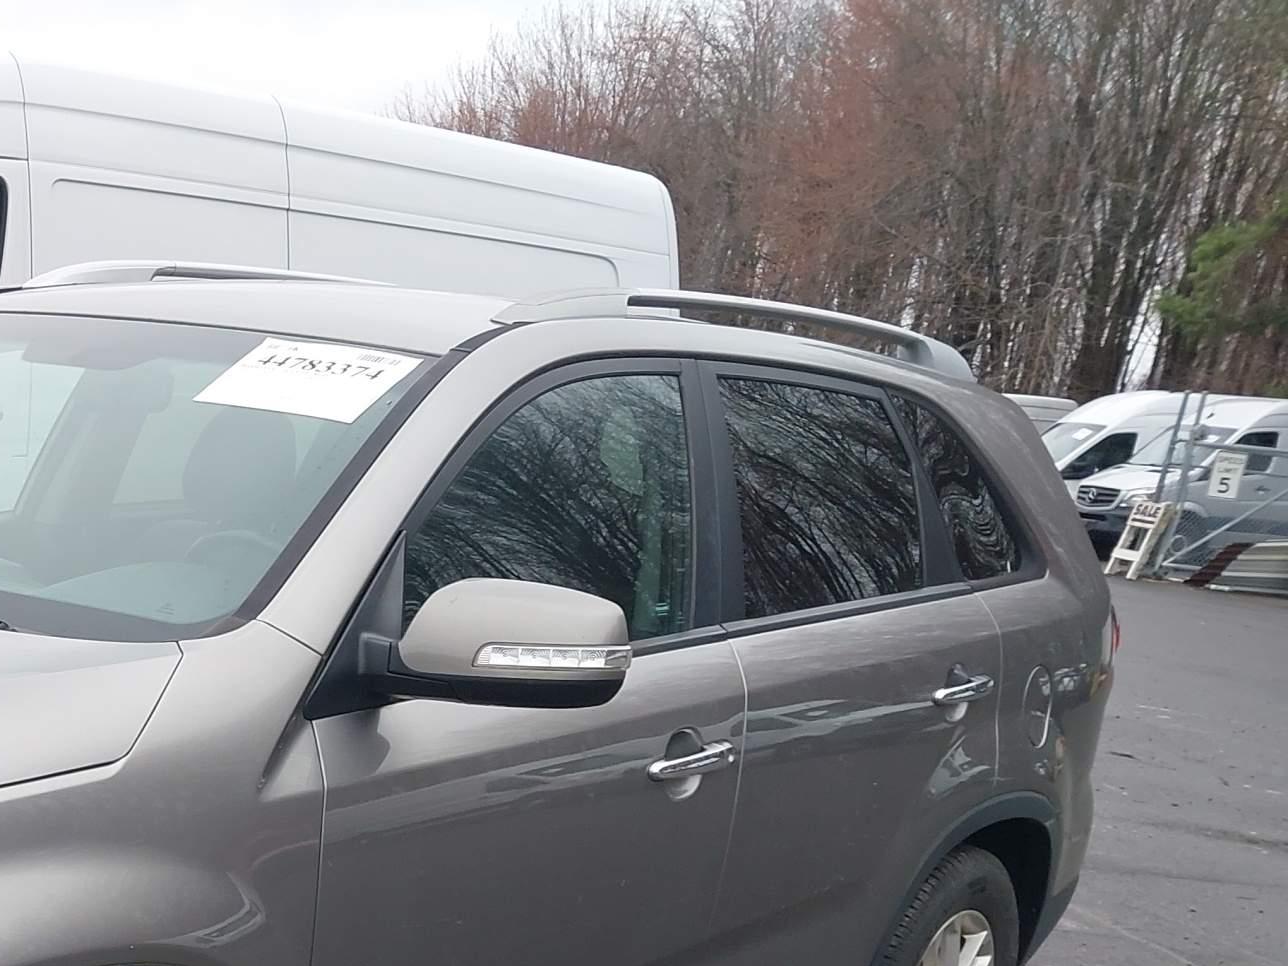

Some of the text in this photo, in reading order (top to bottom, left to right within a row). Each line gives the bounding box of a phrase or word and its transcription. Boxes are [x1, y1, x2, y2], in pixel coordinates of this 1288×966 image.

[258, 354, 385, 380] 44783374
[1217, 477, 1231, 493] 5
[1133, 503, 1161, 518] SALE
